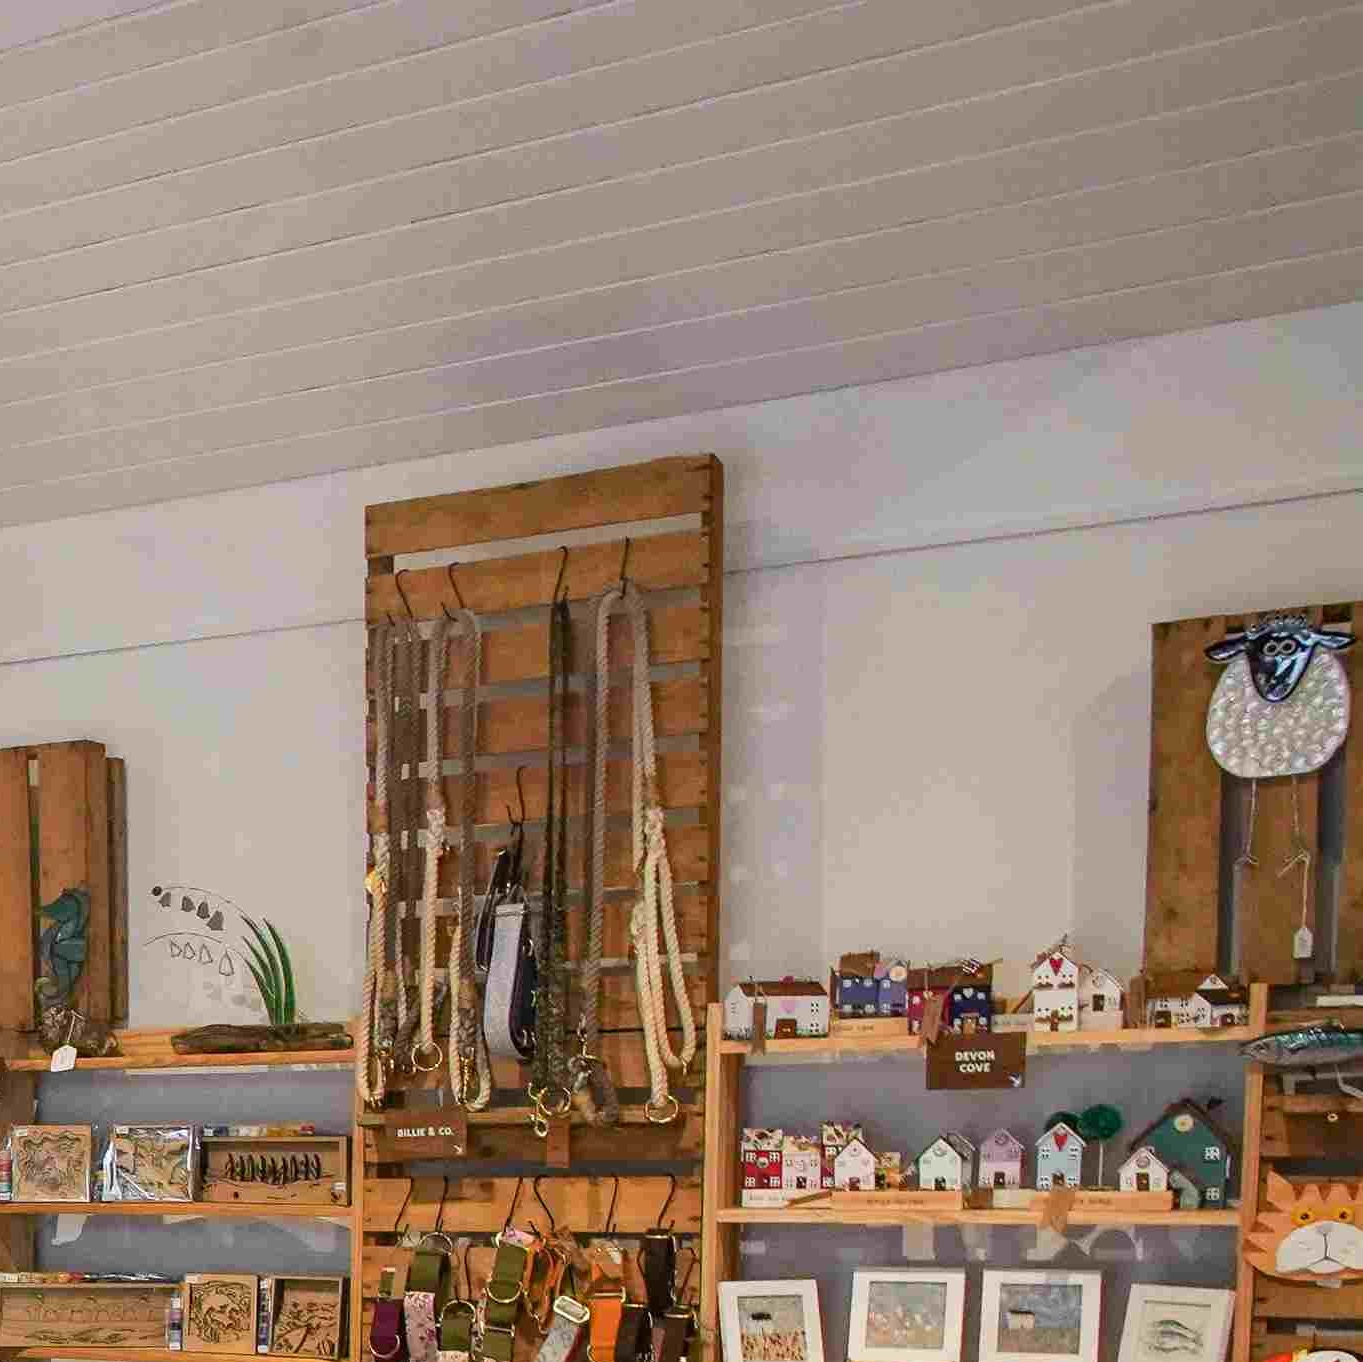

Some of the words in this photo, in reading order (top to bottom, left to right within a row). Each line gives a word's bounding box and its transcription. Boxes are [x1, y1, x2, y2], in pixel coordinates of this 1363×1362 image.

[955, 1049, 995, 1061] DEVON
[959, 1062, 991, 1073] COVE
[397, 1128, 426, 1137] BILLIE
[428, 1127, 435, 1137] &
